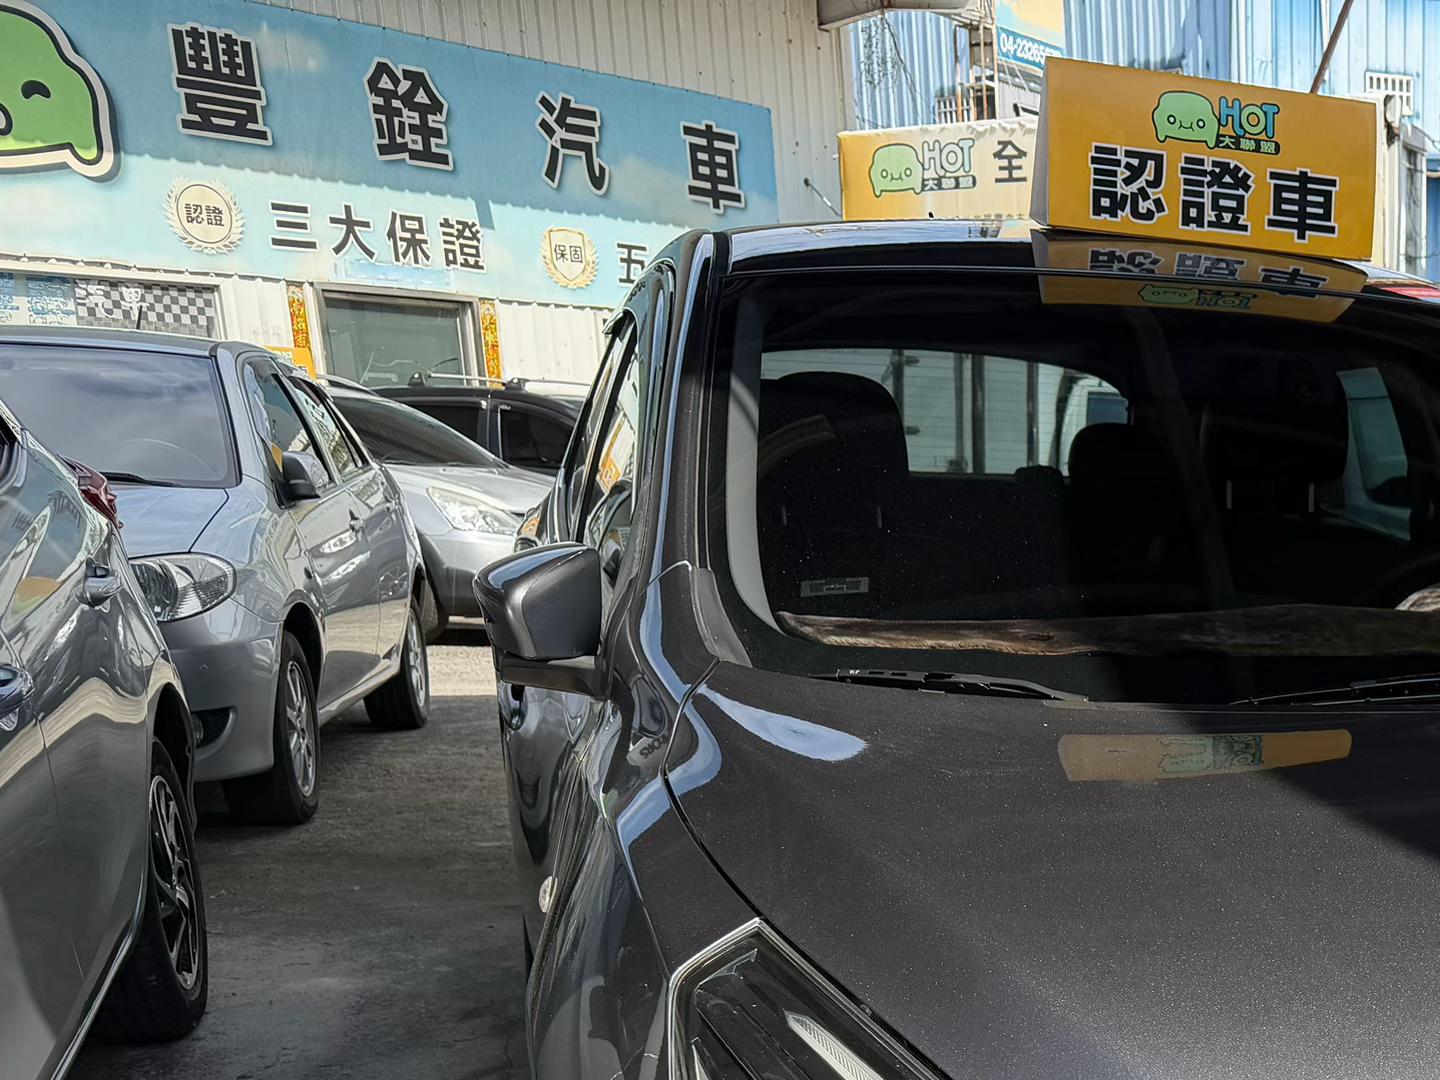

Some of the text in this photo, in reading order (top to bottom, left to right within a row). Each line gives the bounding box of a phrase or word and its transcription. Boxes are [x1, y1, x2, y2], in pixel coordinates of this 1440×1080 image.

[1218, 96, 1280, 138] HOT
[922, 138, 975, 177] HOT
[1218, 135, 1276, 154] 大聯盟
[1089, 143, 1339, 242] 認證車
[184, 203, 225, 227] 認證
[270, 201, 486, 271] 三大保證
[554, 243, 583, 263] 保固
